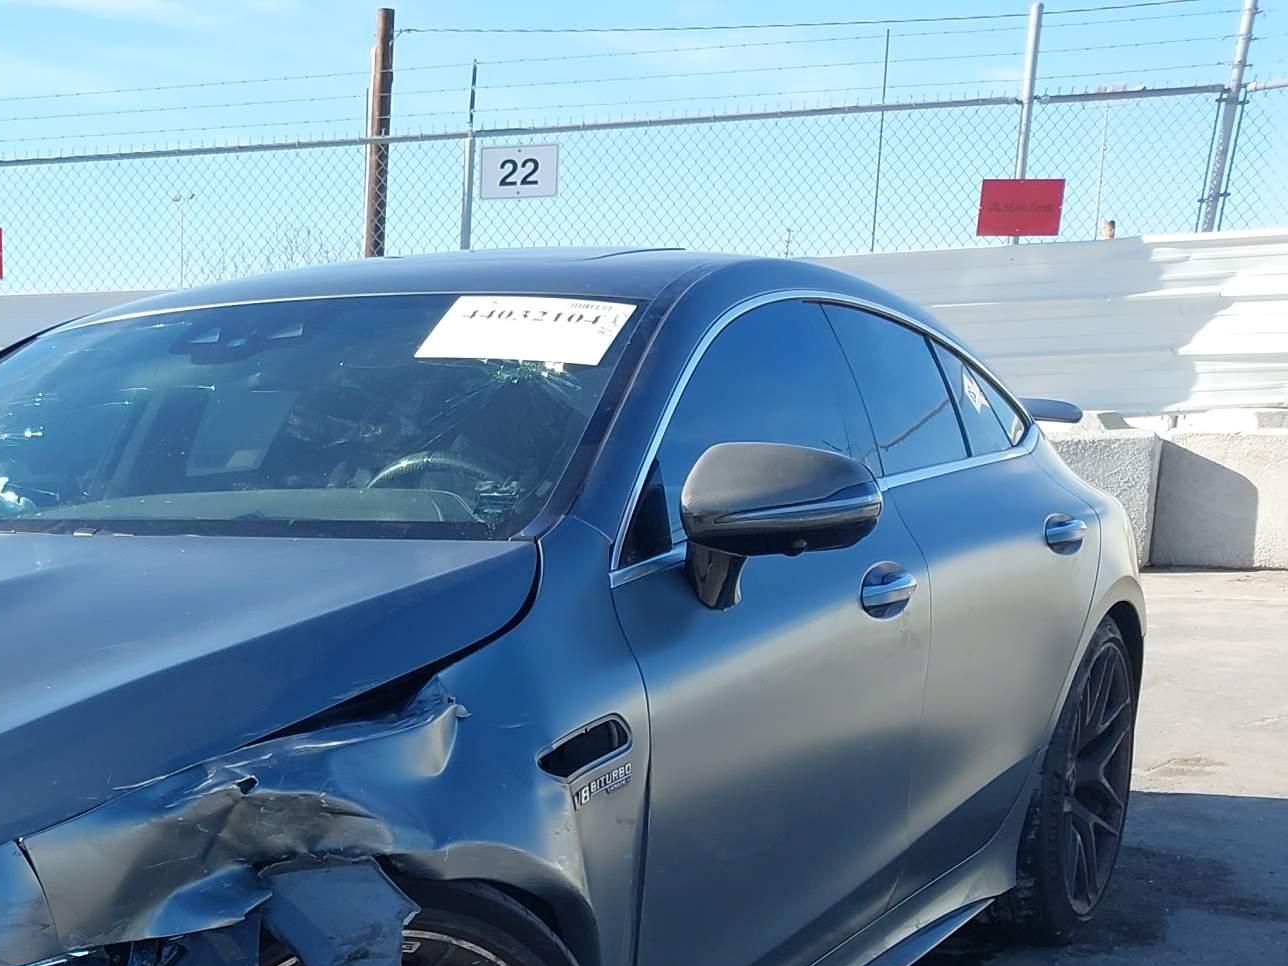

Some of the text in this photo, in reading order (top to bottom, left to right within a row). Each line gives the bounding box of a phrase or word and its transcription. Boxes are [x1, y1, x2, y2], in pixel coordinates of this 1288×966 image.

[499, 157, 540, 187] 22
[463, 307, 603, 326] 44032104
[573, 786, 591, 810] V8
[591, 763, 632, 792] BITURBO
